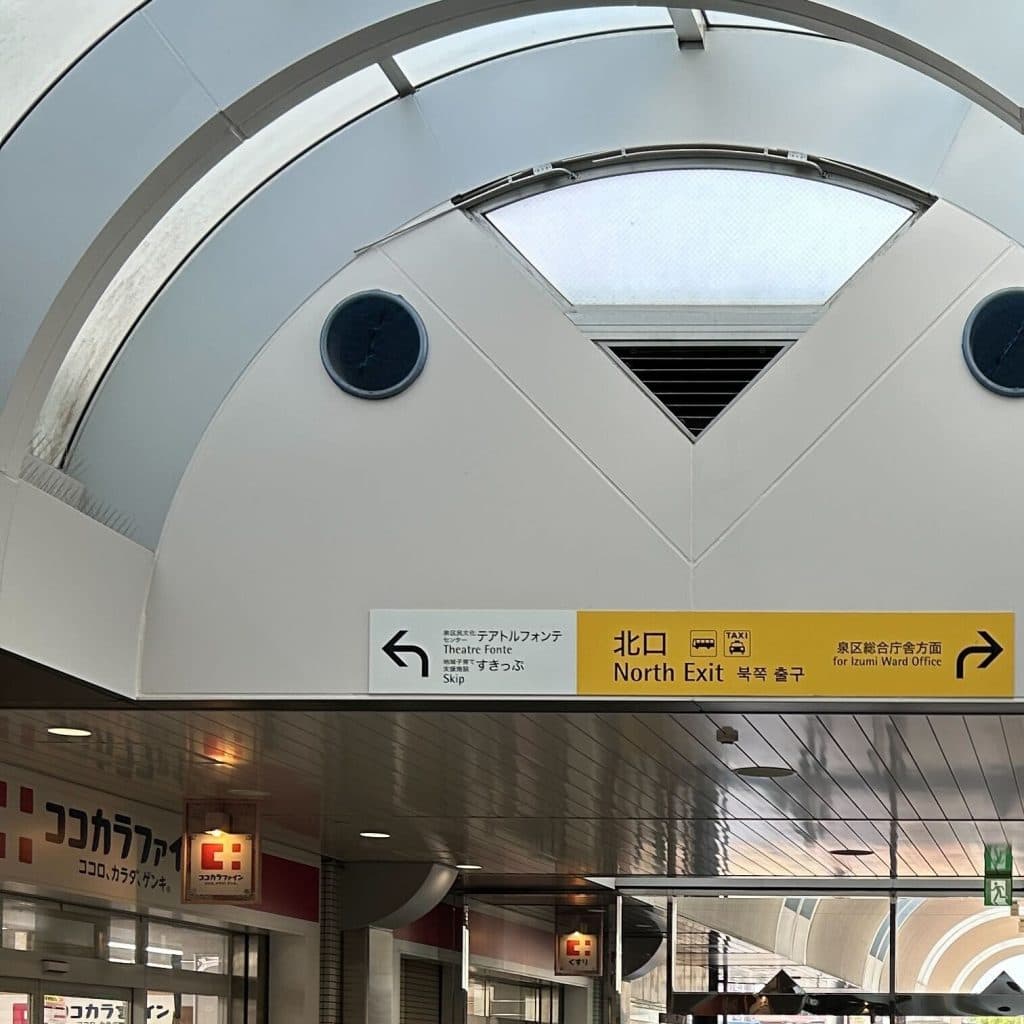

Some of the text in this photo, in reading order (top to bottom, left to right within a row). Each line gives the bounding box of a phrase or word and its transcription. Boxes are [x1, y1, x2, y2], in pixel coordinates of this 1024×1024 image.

[477, 630, 562, 642] テアトルフォンテ
[725, 631, 749, 639] TAXI
[443, 644, 512, 654] Theatre Fonte
[613, 630, 667, 657] 北口
[837, 641, 942, 655] 泉区総合庁舎方面
[476, 659, 524, 672] すきっぷ
[833, 656, 942, 667] for Izumi Ward Office
[613, 662, 725, 682] North Exit
[737, 666, 806, 682] 북쪽 출구
[443, 674, 465, 686] Skip
[45, 802, 183, 872] ココカラファイ
